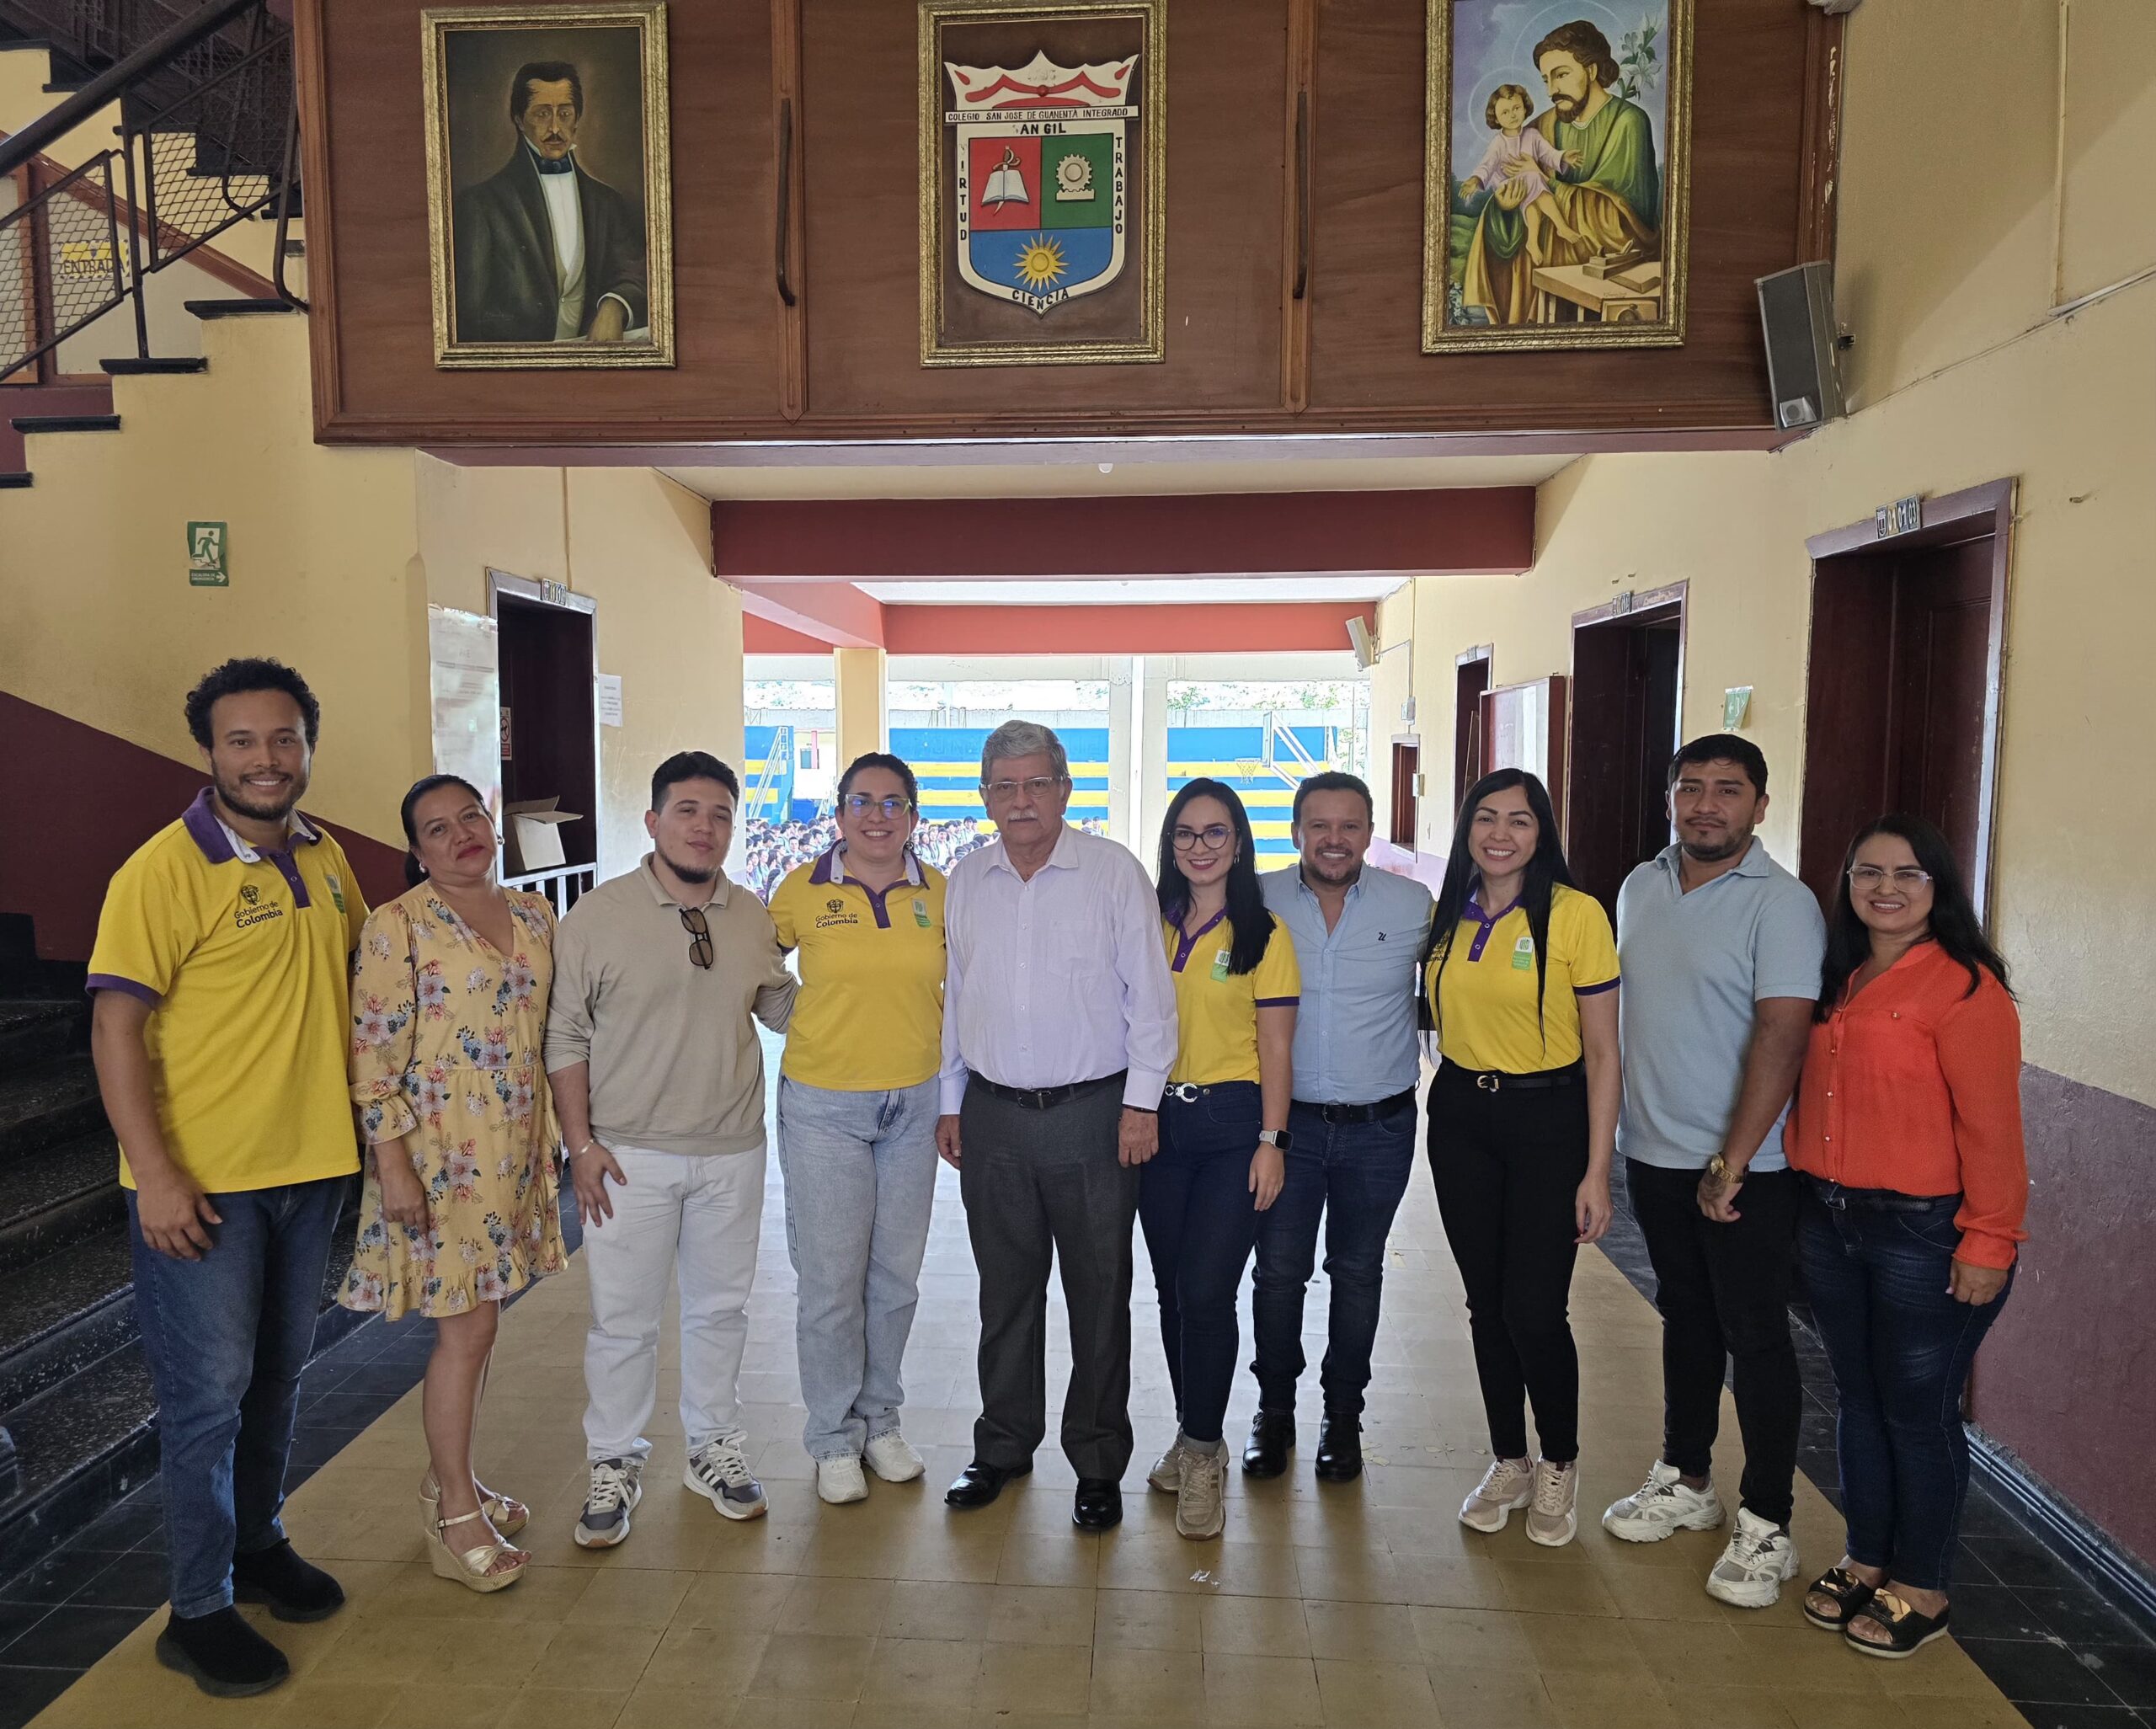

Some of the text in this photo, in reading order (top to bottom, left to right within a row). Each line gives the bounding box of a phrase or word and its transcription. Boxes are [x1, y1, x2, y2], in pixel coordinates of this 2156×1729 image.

[948, 112, 980, 120] COLEGIO
[986, 111, 1001, 120] SAN
[1005, 111, 1023, 120] JOSE
[1027, 111, 1037, 120] DE
[1083, 107, 1128, 117] INTEGRADO
[1044, 122, 1066, 135] GIL
[1115, 136, 1123, 234] TRABAJO
[1012, 287, 1070, 310] CIENCIA
[234, 900, 279, 919] Gobierno de
[236, 909, 283, 928] Colombia
[815, 914, 847, 922] Gobierno
[816, 917, 858, 928] Colombia
